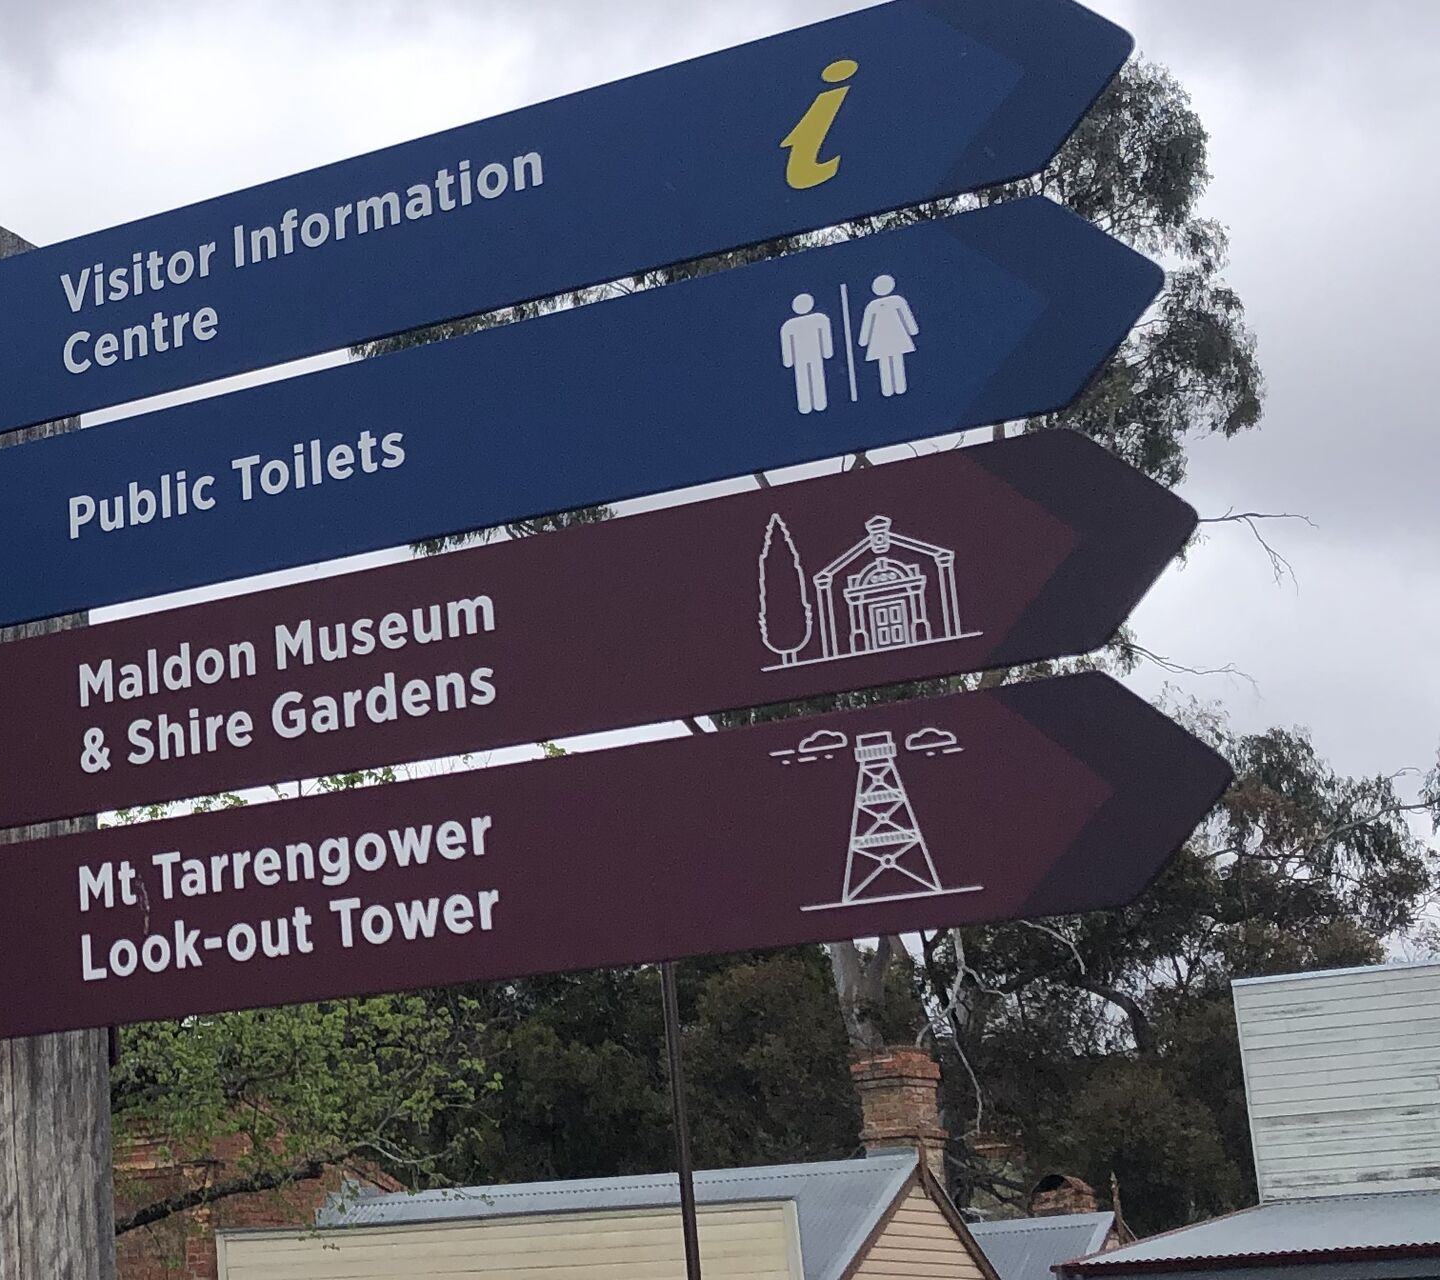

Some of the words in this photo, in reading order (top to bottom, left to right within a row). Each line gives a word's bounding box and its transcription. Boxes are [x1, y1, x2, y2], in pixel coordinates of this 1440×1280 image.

[60, 241, 216, 313] Visitor
[233, 151, 543, 268] Information
[63, 306, 218, 374] Centre
[69, 470, 216, 540] Public
[231, 430, 406, 501] Toilets
[78, 641, 257, 708] Maldon
[274, 595, 495, 670] Museum
[80, 727, 111, 773] &
[127, 708, 254, 765] Shire
[271, 667, 496, 739] Gardens
[78, 860, 137, 912] Mt
[152, 815, 492, 900] Tarrengower
[81, 906, 314, 981] Look-out
[329, 889, 499, 948] Tower
